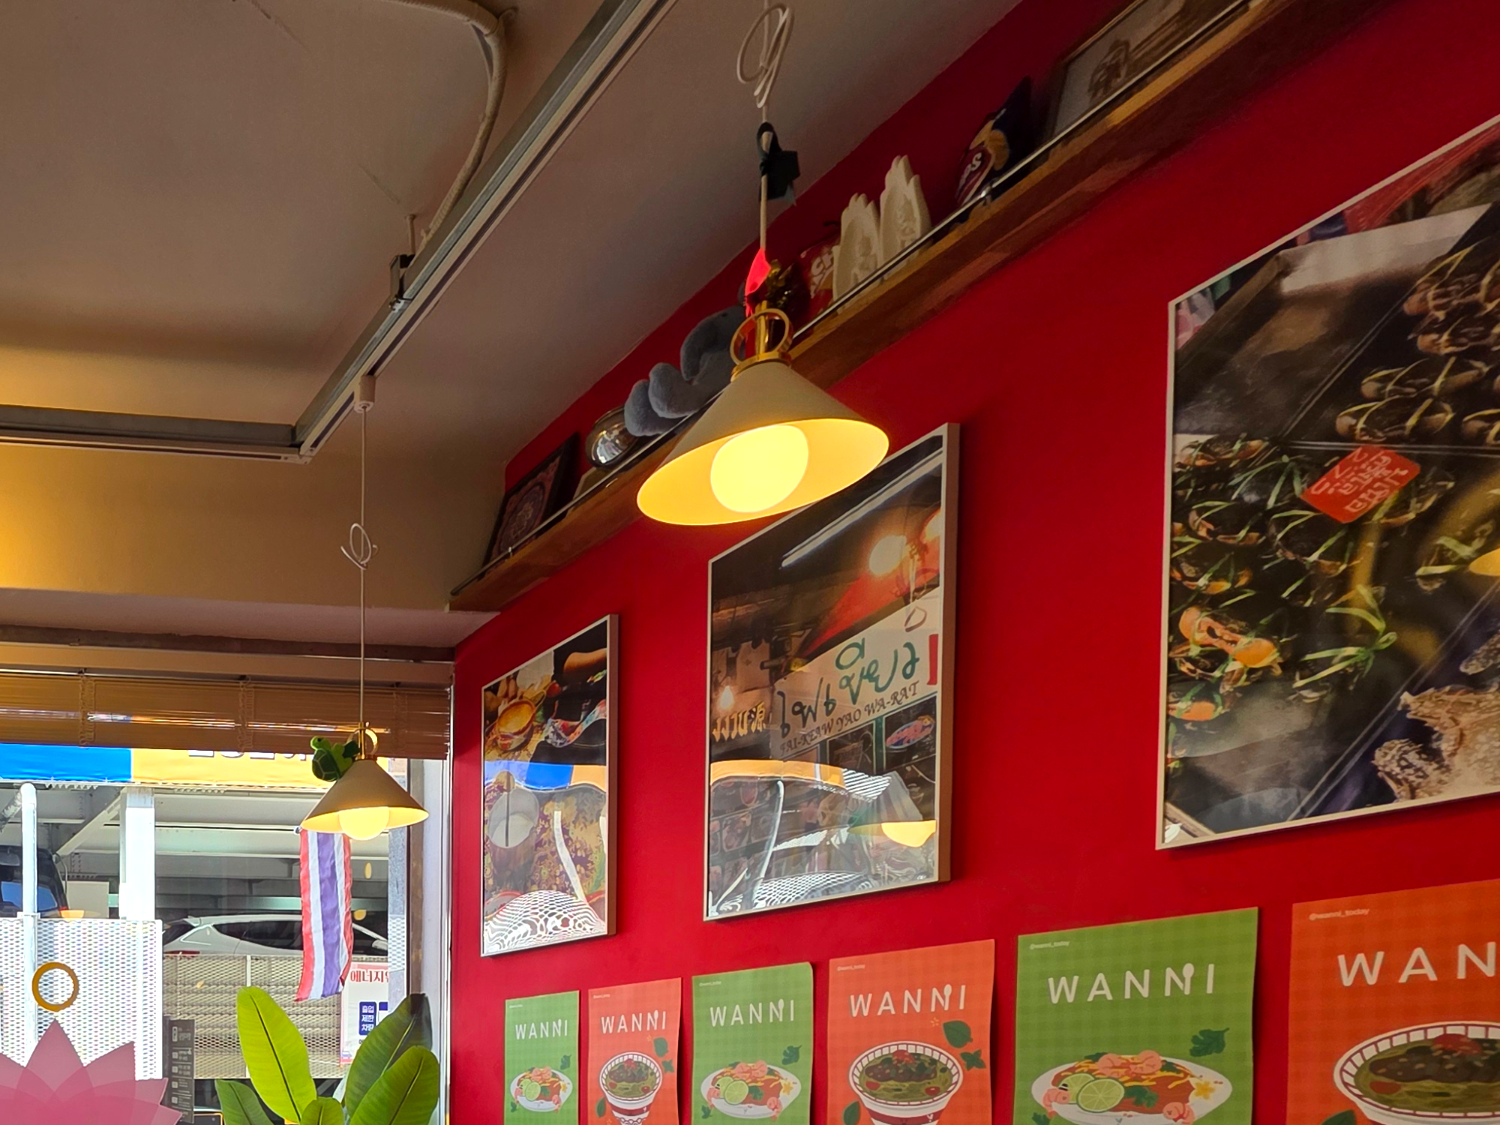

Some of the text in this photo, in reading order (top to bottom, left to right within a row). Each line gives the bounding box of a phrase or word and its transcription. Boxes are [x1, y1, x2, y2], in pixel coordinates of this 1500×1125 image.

[350, 969, 389, 983] 에너지
[1047, 962, 1215, 1004] WANNI
[709, 998, 794, 1027] WANNI
[850, 983, 966, 1018] WANNI
[515, 1018, 568, 1040] WANNI
[601, 1009, 666, 1035] WANNI
